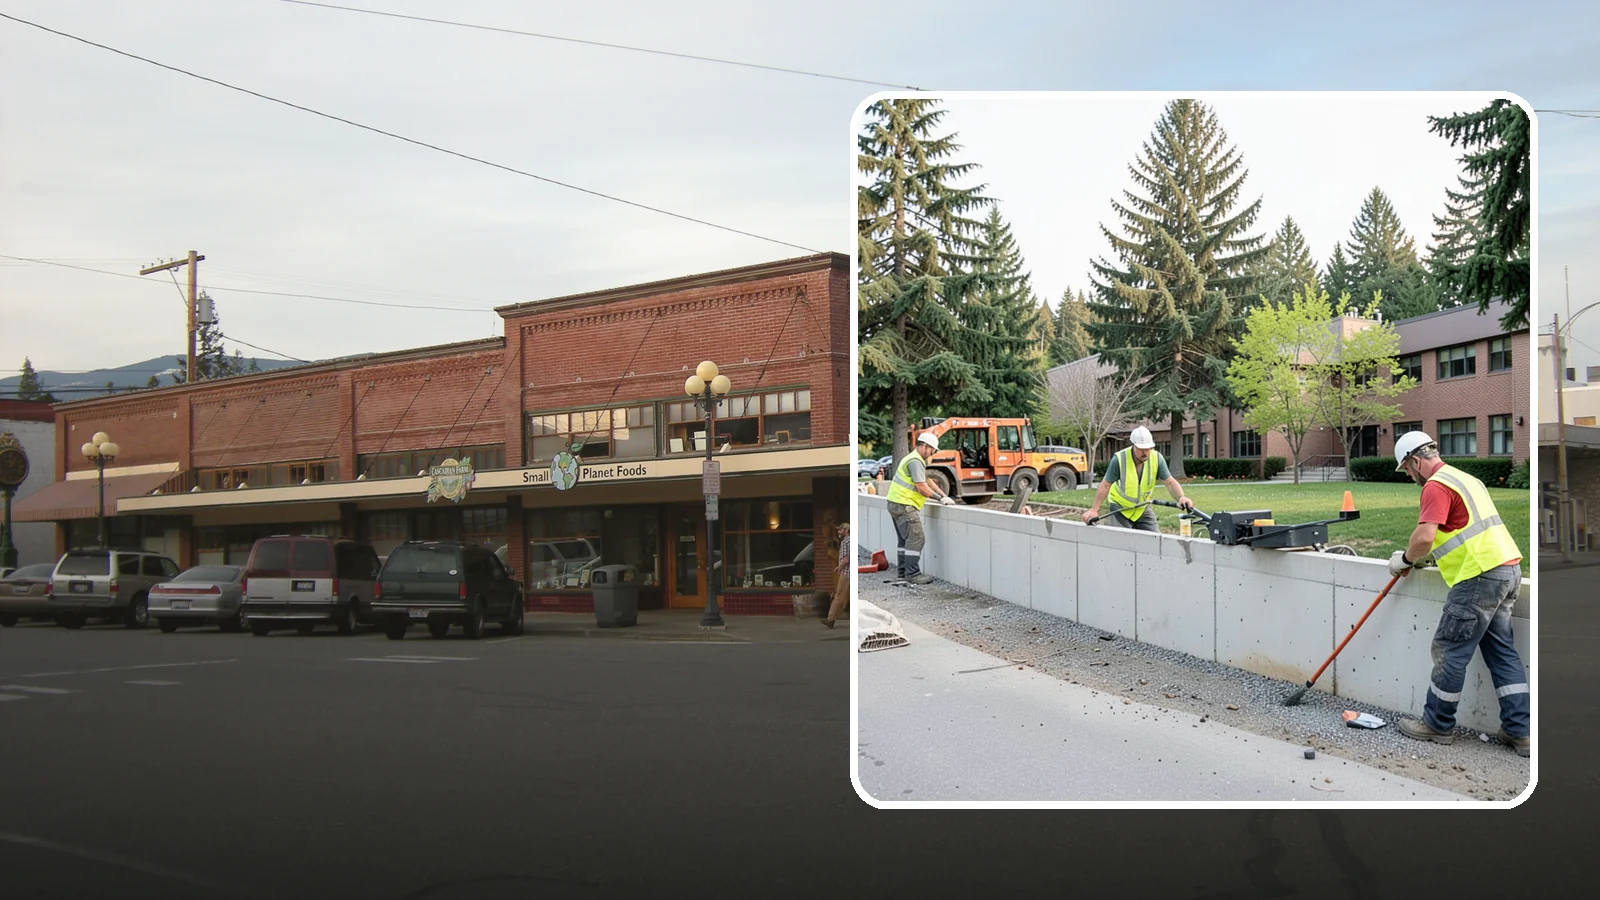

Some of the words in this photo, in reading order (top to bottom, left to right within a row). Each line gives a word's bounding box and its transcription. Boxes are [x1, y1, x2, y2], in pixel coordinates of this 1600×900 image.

[523, 471, 549, 483] Small
[583, 467, 614, 479] Planet
[617, 464, 647, 477] Foods
